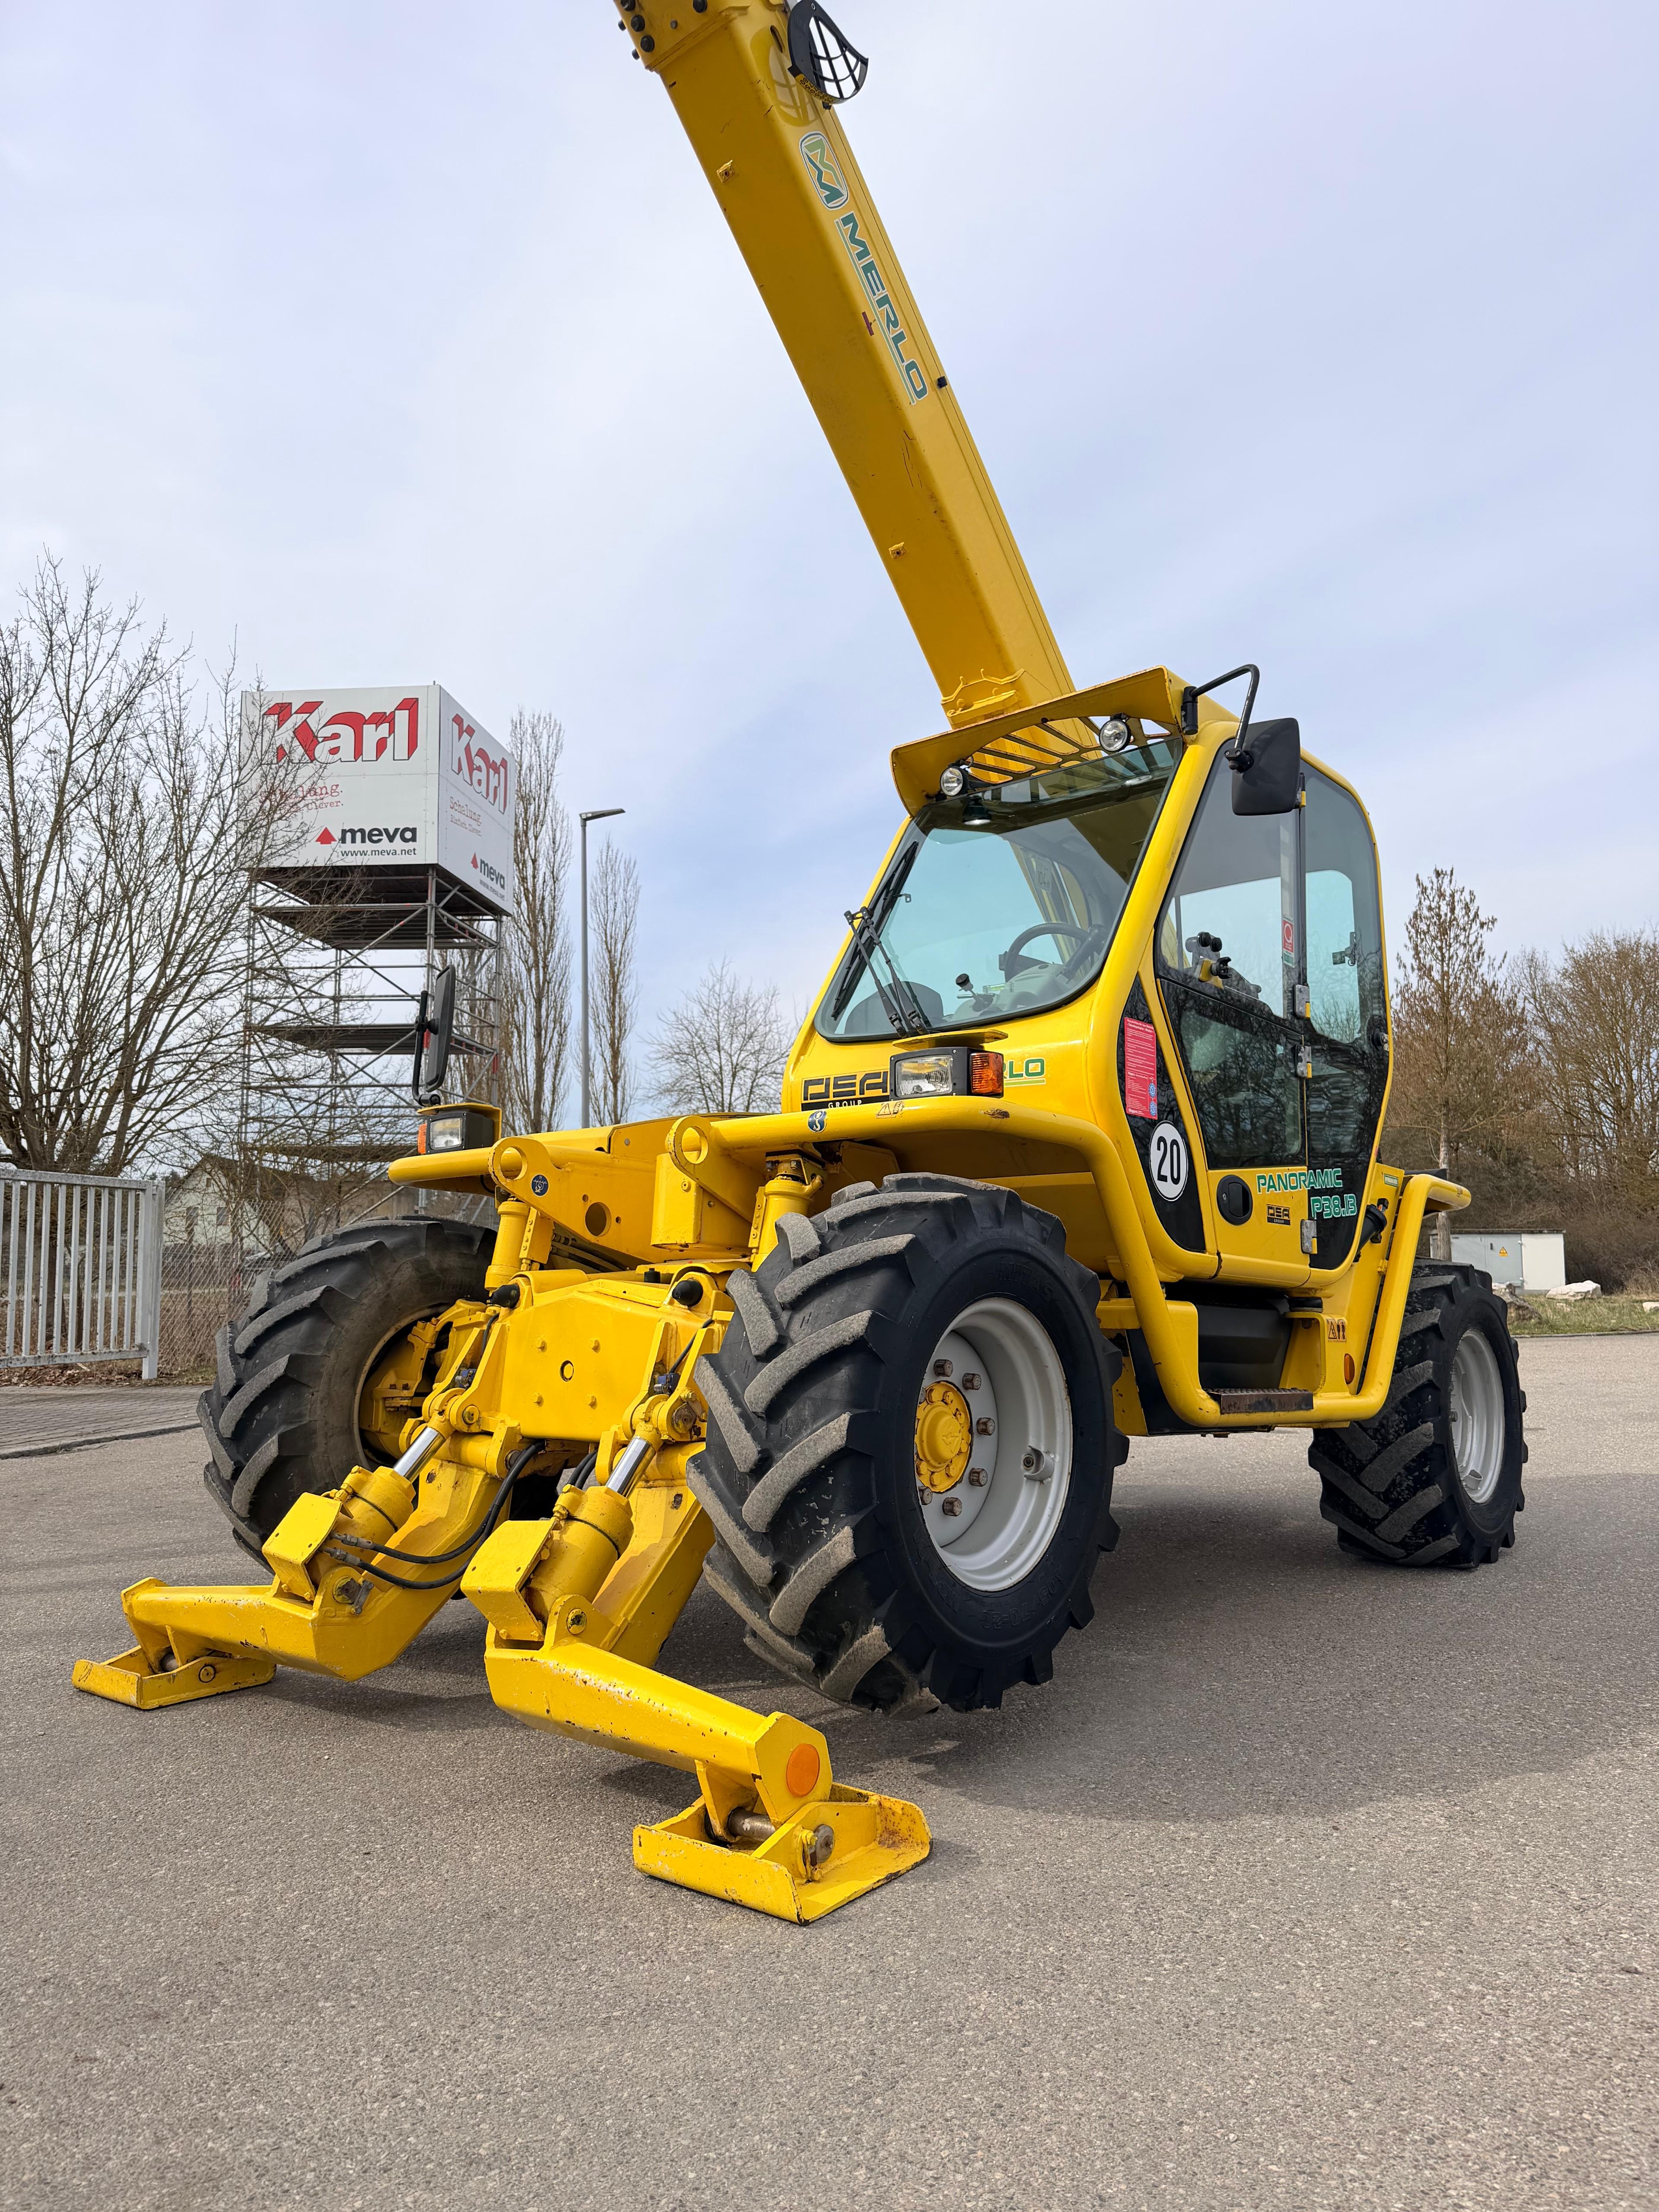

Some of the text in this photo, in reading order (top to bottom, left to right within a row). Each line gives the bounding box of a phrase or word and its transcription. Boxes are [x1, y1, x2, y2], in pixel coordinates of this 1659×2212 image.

[840, 210, 928, 400] MERLO
[261, 697, 419, 764] Karl
[452, 713, 508, 815] Karl
[341, 826, 417, 844] meva
[340, 847, 417, 857] www.meva.net
[480, 858, 505, 890] meva
[828, 1100, 862, 1109] GROUP
[1157, 1136, 1180, 1185] 20
[1256, 1168, 1343, 1194] PANORAMIC
[1310, 1194, 1357, 1220] P38.13
